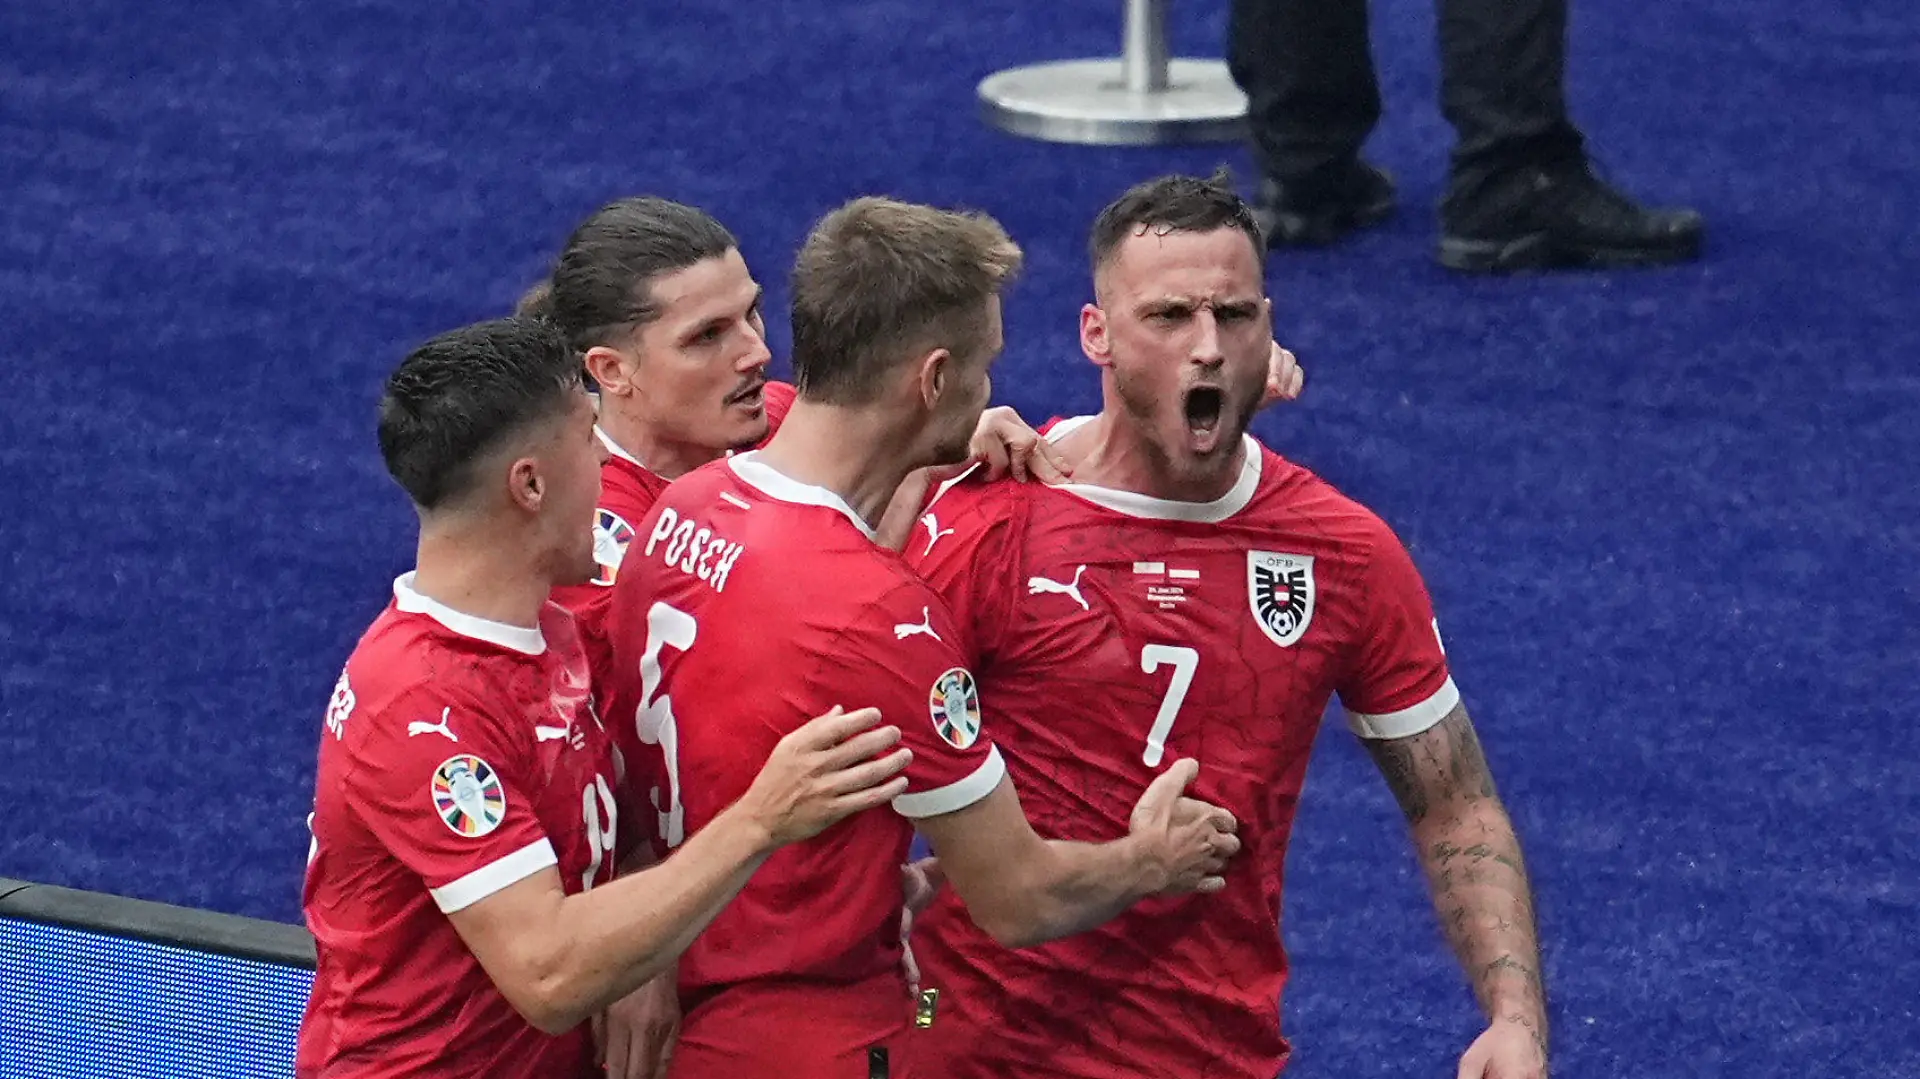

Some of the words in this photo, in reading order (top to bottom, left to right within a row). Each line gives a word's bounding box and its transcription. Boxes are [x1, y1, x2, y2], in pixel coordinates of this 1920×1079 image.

[645, 507, 744, 593] POSCH
[636, 601, 697, 848] 5
[1141, 644, 1198, 768] 7
